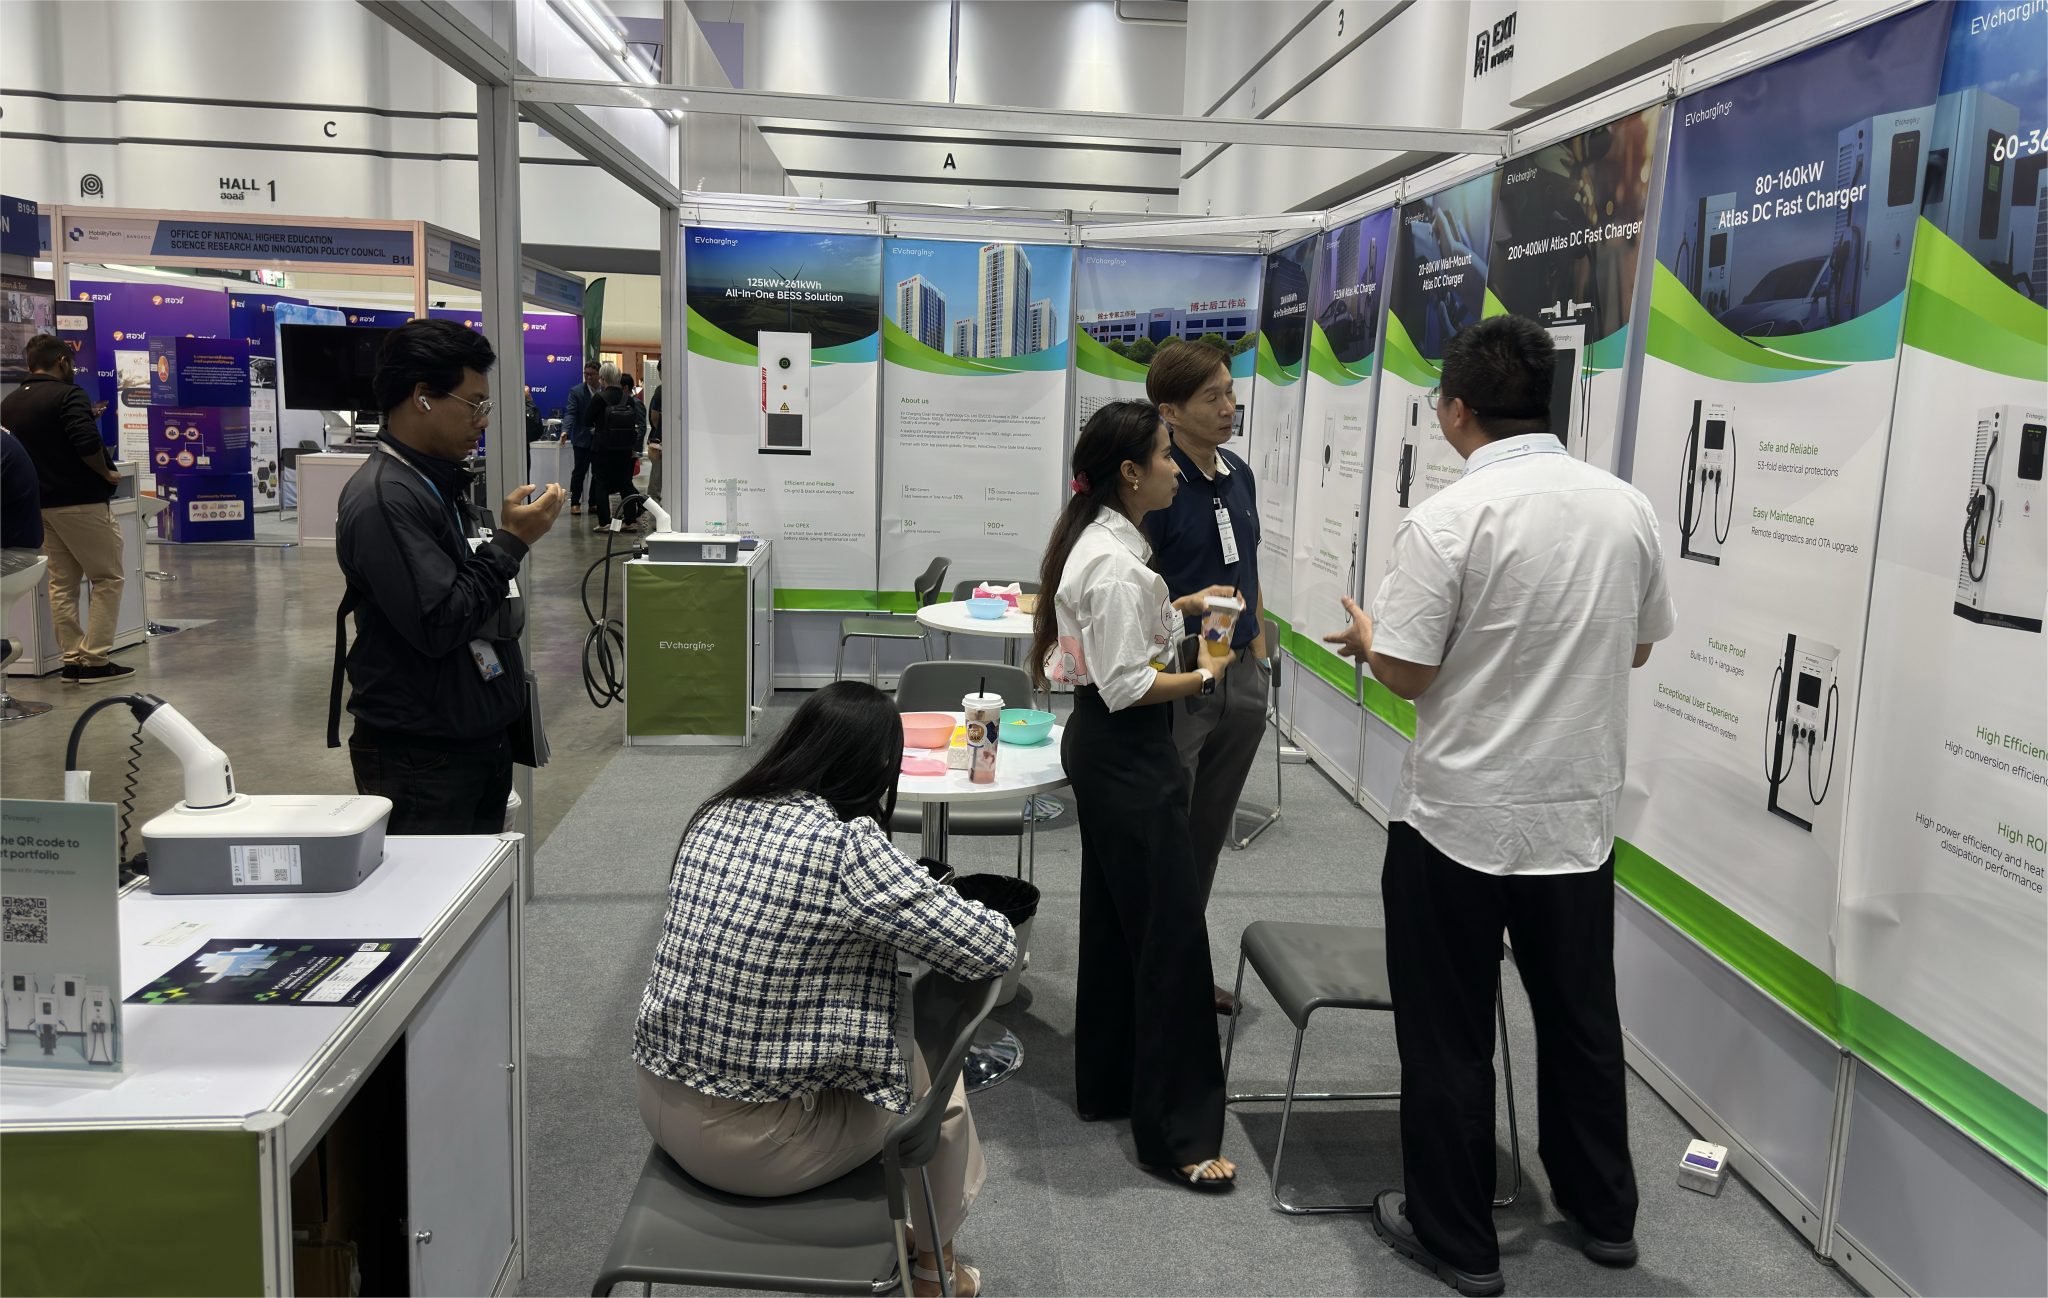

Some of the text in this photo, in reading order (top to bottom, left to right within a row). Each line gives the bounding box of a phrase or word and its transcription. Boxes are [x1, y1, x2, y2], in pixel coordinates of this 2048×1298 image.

[1338, 8, 1345, 37] 3
[1492, 11, 1517, 47] EXIT
[1685, 101, 1733, 127] EVcharging
[324, 121, 337, 138] C
[943, 153, 957, 170] A
[1755, 160, 1825, 196] 80-160kW
[219, 177, 276, 202] HALL 1
[220, 191, 245, 201] ฮอลล์
[17, 202, 36, 215] B19-2
[1718, 182, 1866, 230] Atlas DC Fast Charger
[88, 229, 122, 238] MobilityTech
[170, 229, 333, 245] OFFICE OF NATIONAL HIGHER EDUCATION
[695, 236, 738, 247] EVcharging
[1508, 219, 1642, 261] 200-400kW Atlas DC Fast Charger
[171, 240, 386, 258] SCIENCE RESEARCH AND INNOVATION POLICY COUNCIL
[892, 247, 935, 257] EVcharging
[392, 255, 411, 264] B11
[1440, 252, 1472, 271] Wall-Mount
[747, 278, 822, 290] 125kW+261kWh
[1360, 282, 1377, 296] Charger
[1422, 273, 1464, 291] Atlas DC Charger
[725, 289, 844, 302] All-In-One BESS Solution
[1190, 298, 1247, 313] 博士后工作站
[900, 397, 920, 405] About
[1759, 441, 1819, 456] Safe and Reliable
[1757, 460, 1839, 477] 53-fold electrical protections
[1752, 506, 1815, 526] Easy Maintenance
[1751, 526, 1859, 554] Remote diagnostics and OTA upgrade
[659, 641, 715, 651] EVcharging
[1708, 637, 1747, 659] Future Proof
[1719, 660, 1745, 677] languages
[1658, 683, 1739, 724] Exceptional User Experience
[1653, 698, 1737, 741] User-friendly cable retraction system
[1976, 725, 2001, 746] High
[1944, 739, 1964, 756] High
[1965, 748, 2010, 773] conversion
[1997, 821, 2024, 844] High
[17, 836, 34, 847] QR
[36, 837, 65, 848] code
[67, 838, 80, 848] to
[1915, 811, 2045, 879] High power efficiency and heat
[10, 850, 60, 861] portfolio
[1940, 839, 2043, 894] dissipation performance
